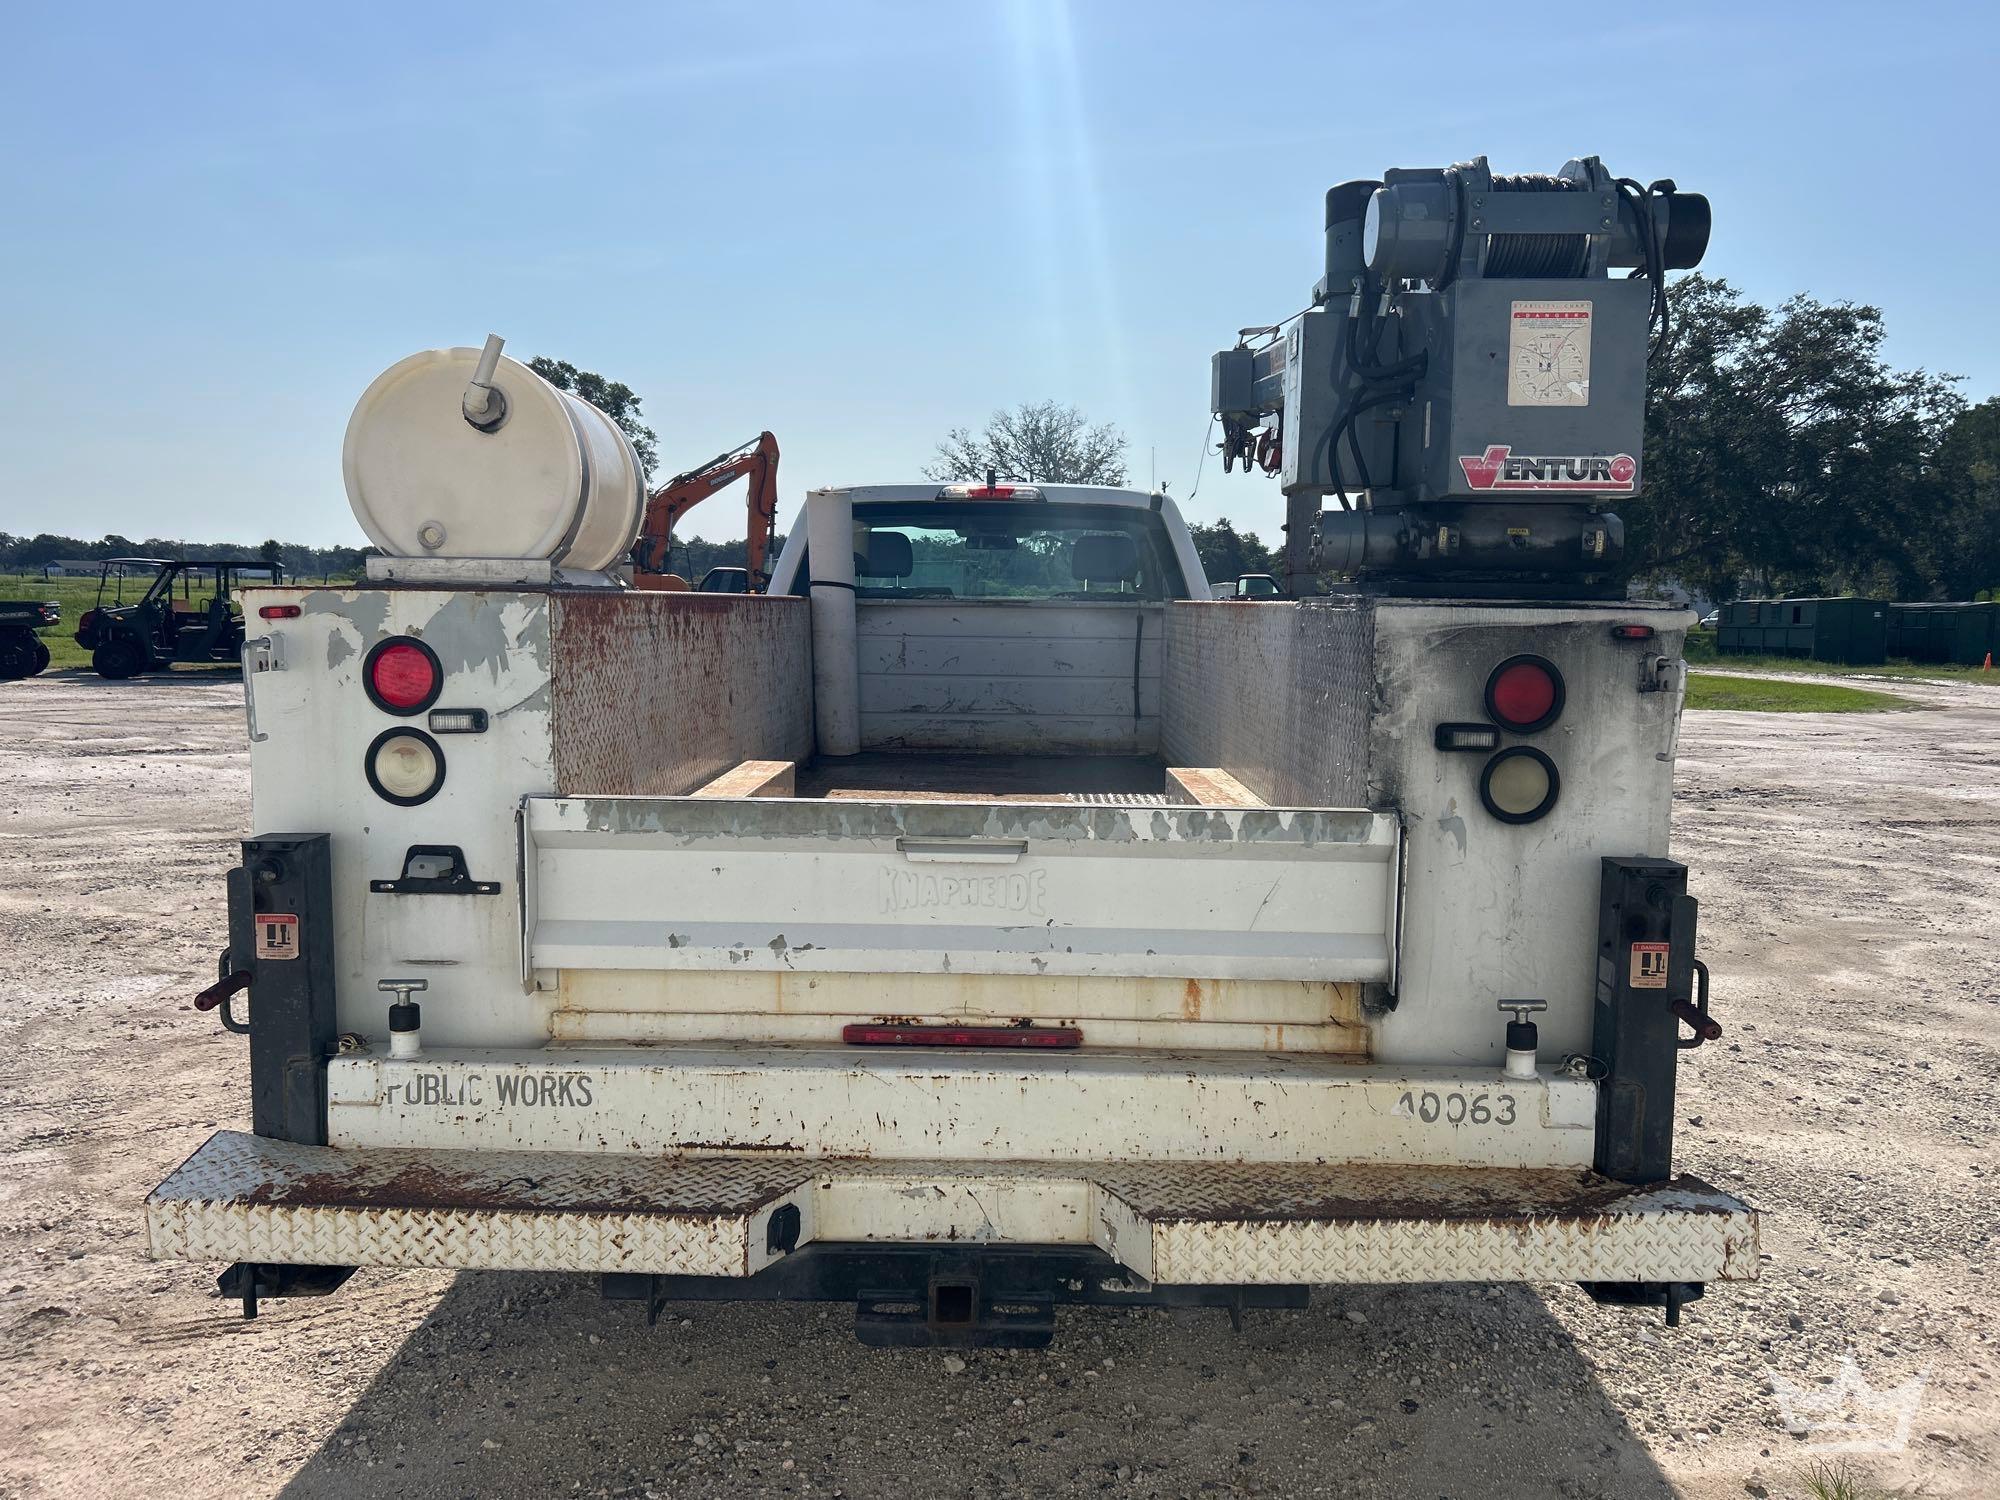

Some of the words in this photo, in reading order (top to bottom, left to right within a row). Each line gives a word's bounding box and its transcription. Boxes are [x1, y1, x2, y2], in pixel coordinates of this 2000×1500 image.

[1461, 447, 1636, 489] VENTURO
[879, 865, 1047, 917] KNAPHEIDE
[387, 1073, 483, 1106] PUBLIC
[496, 1074, 593, 1107] WORKS
